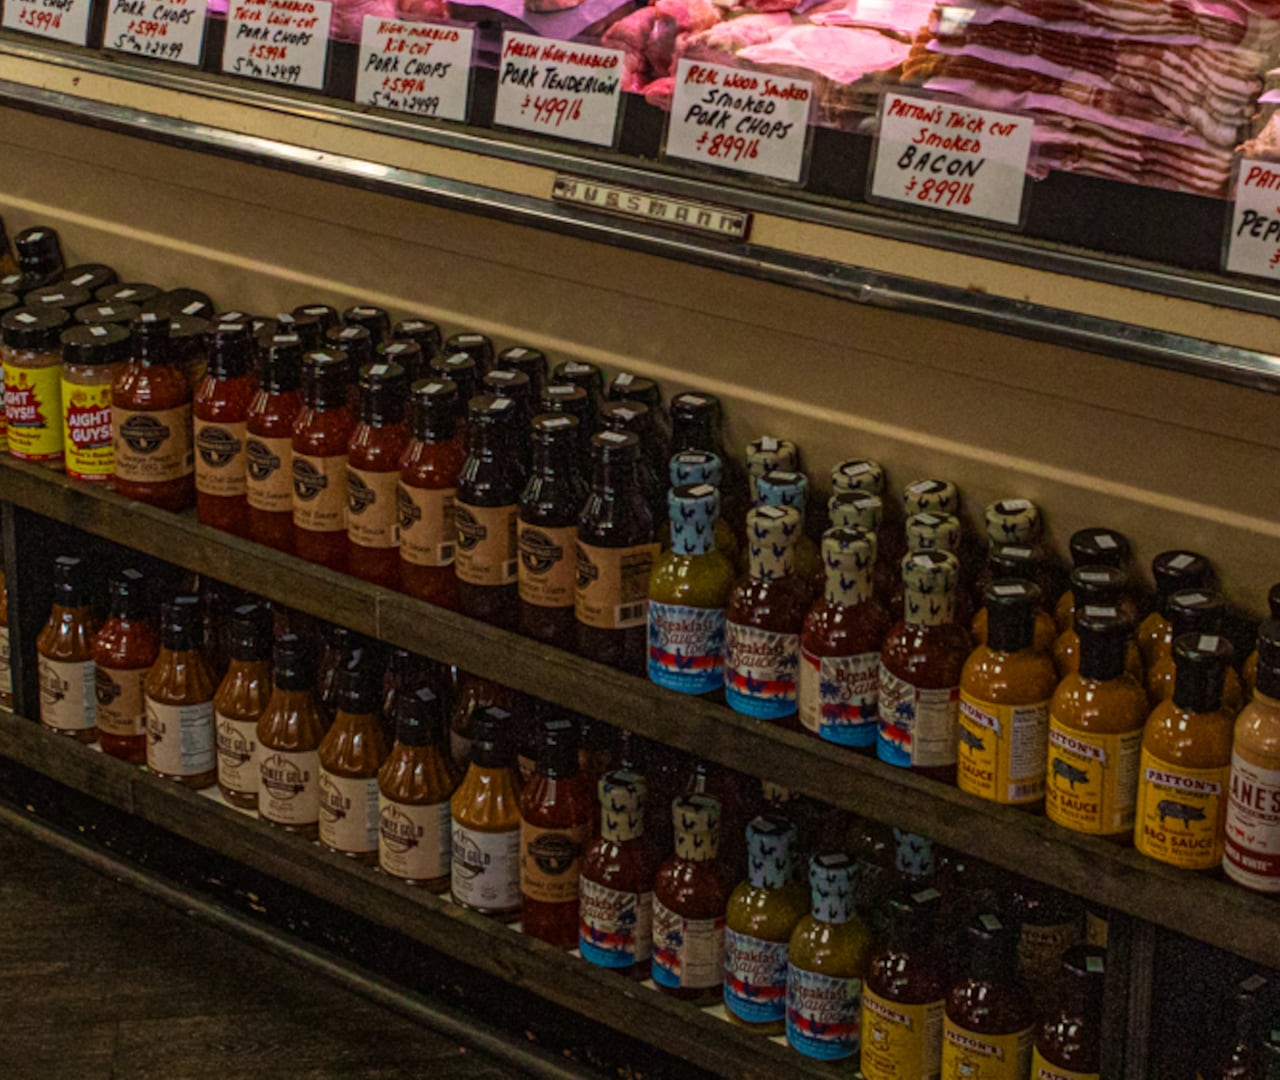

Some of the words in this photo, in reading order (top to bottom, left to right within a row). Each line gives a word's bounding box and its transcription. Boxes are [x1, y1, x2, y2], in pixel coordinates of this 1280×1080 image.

[152, 1, 196, 26] CHOPS
[236, 23, 269, 42] PORK
[271, 27, 314, 46] CHOPS
[503, 37, 539, 61] FRESH
[365, 52, 400, 73] PORK
[403, 58, 453, 79] CHOPS
[500, 61, 538, 87] PORK
[684, 65, 718, 88] REAL
[723, 71, 758, 92] WOOD
[759, 78, 810, 102] SMOKED
[519, 93, 582, 129] $4.99lb
[701, 88, 777, 116] SMOKED
[684, 105, 726, 130] PORK
[734, 112, 795, 141] CHOPS
[887, 98, 944, 124] PATTON'S
[989, 121, 1019, 137] CUT
[695, 131, 761, 162] $8.99lb
[912, 127, 981, 153] SMOKED
[897, 145, 985, 178] BACON
[904, 175, 975, 206] $8.99lb
[69, 409, 111, 427] AIGHT
[1148, 770, 1219, 793] PATTON'S
[1060, 795, 1099, 816] SAUCE
[1142, 824, 1167, 845] BBQ
[1169, 834, 1214, 850] SAUCE
